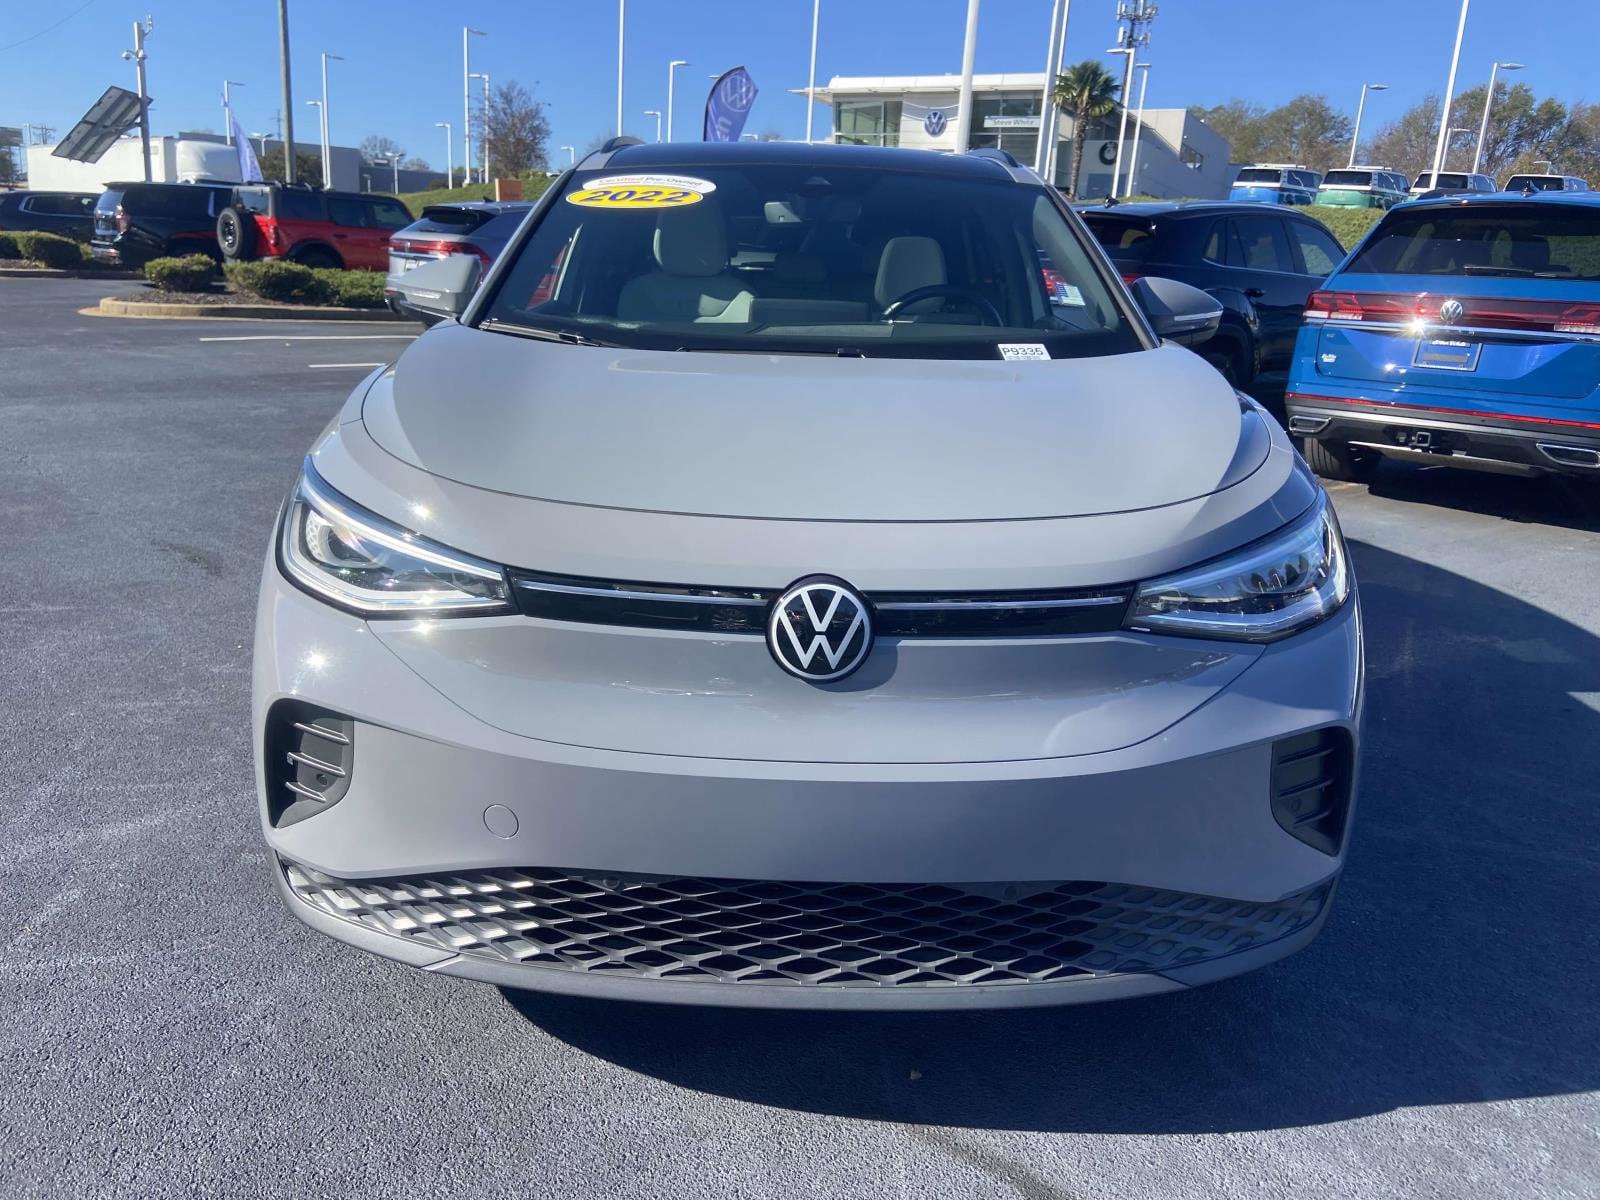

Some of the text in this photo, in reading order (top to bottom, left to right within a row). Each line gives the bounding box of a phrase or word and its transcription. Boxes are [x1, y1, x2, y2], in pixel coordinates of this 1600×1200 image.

[925, 111, 947, 136] VW
[579, 190, 691, 202] 2022
[1001, 347, 1044, 356] P9335
[777, 587, 865, 671] VW
